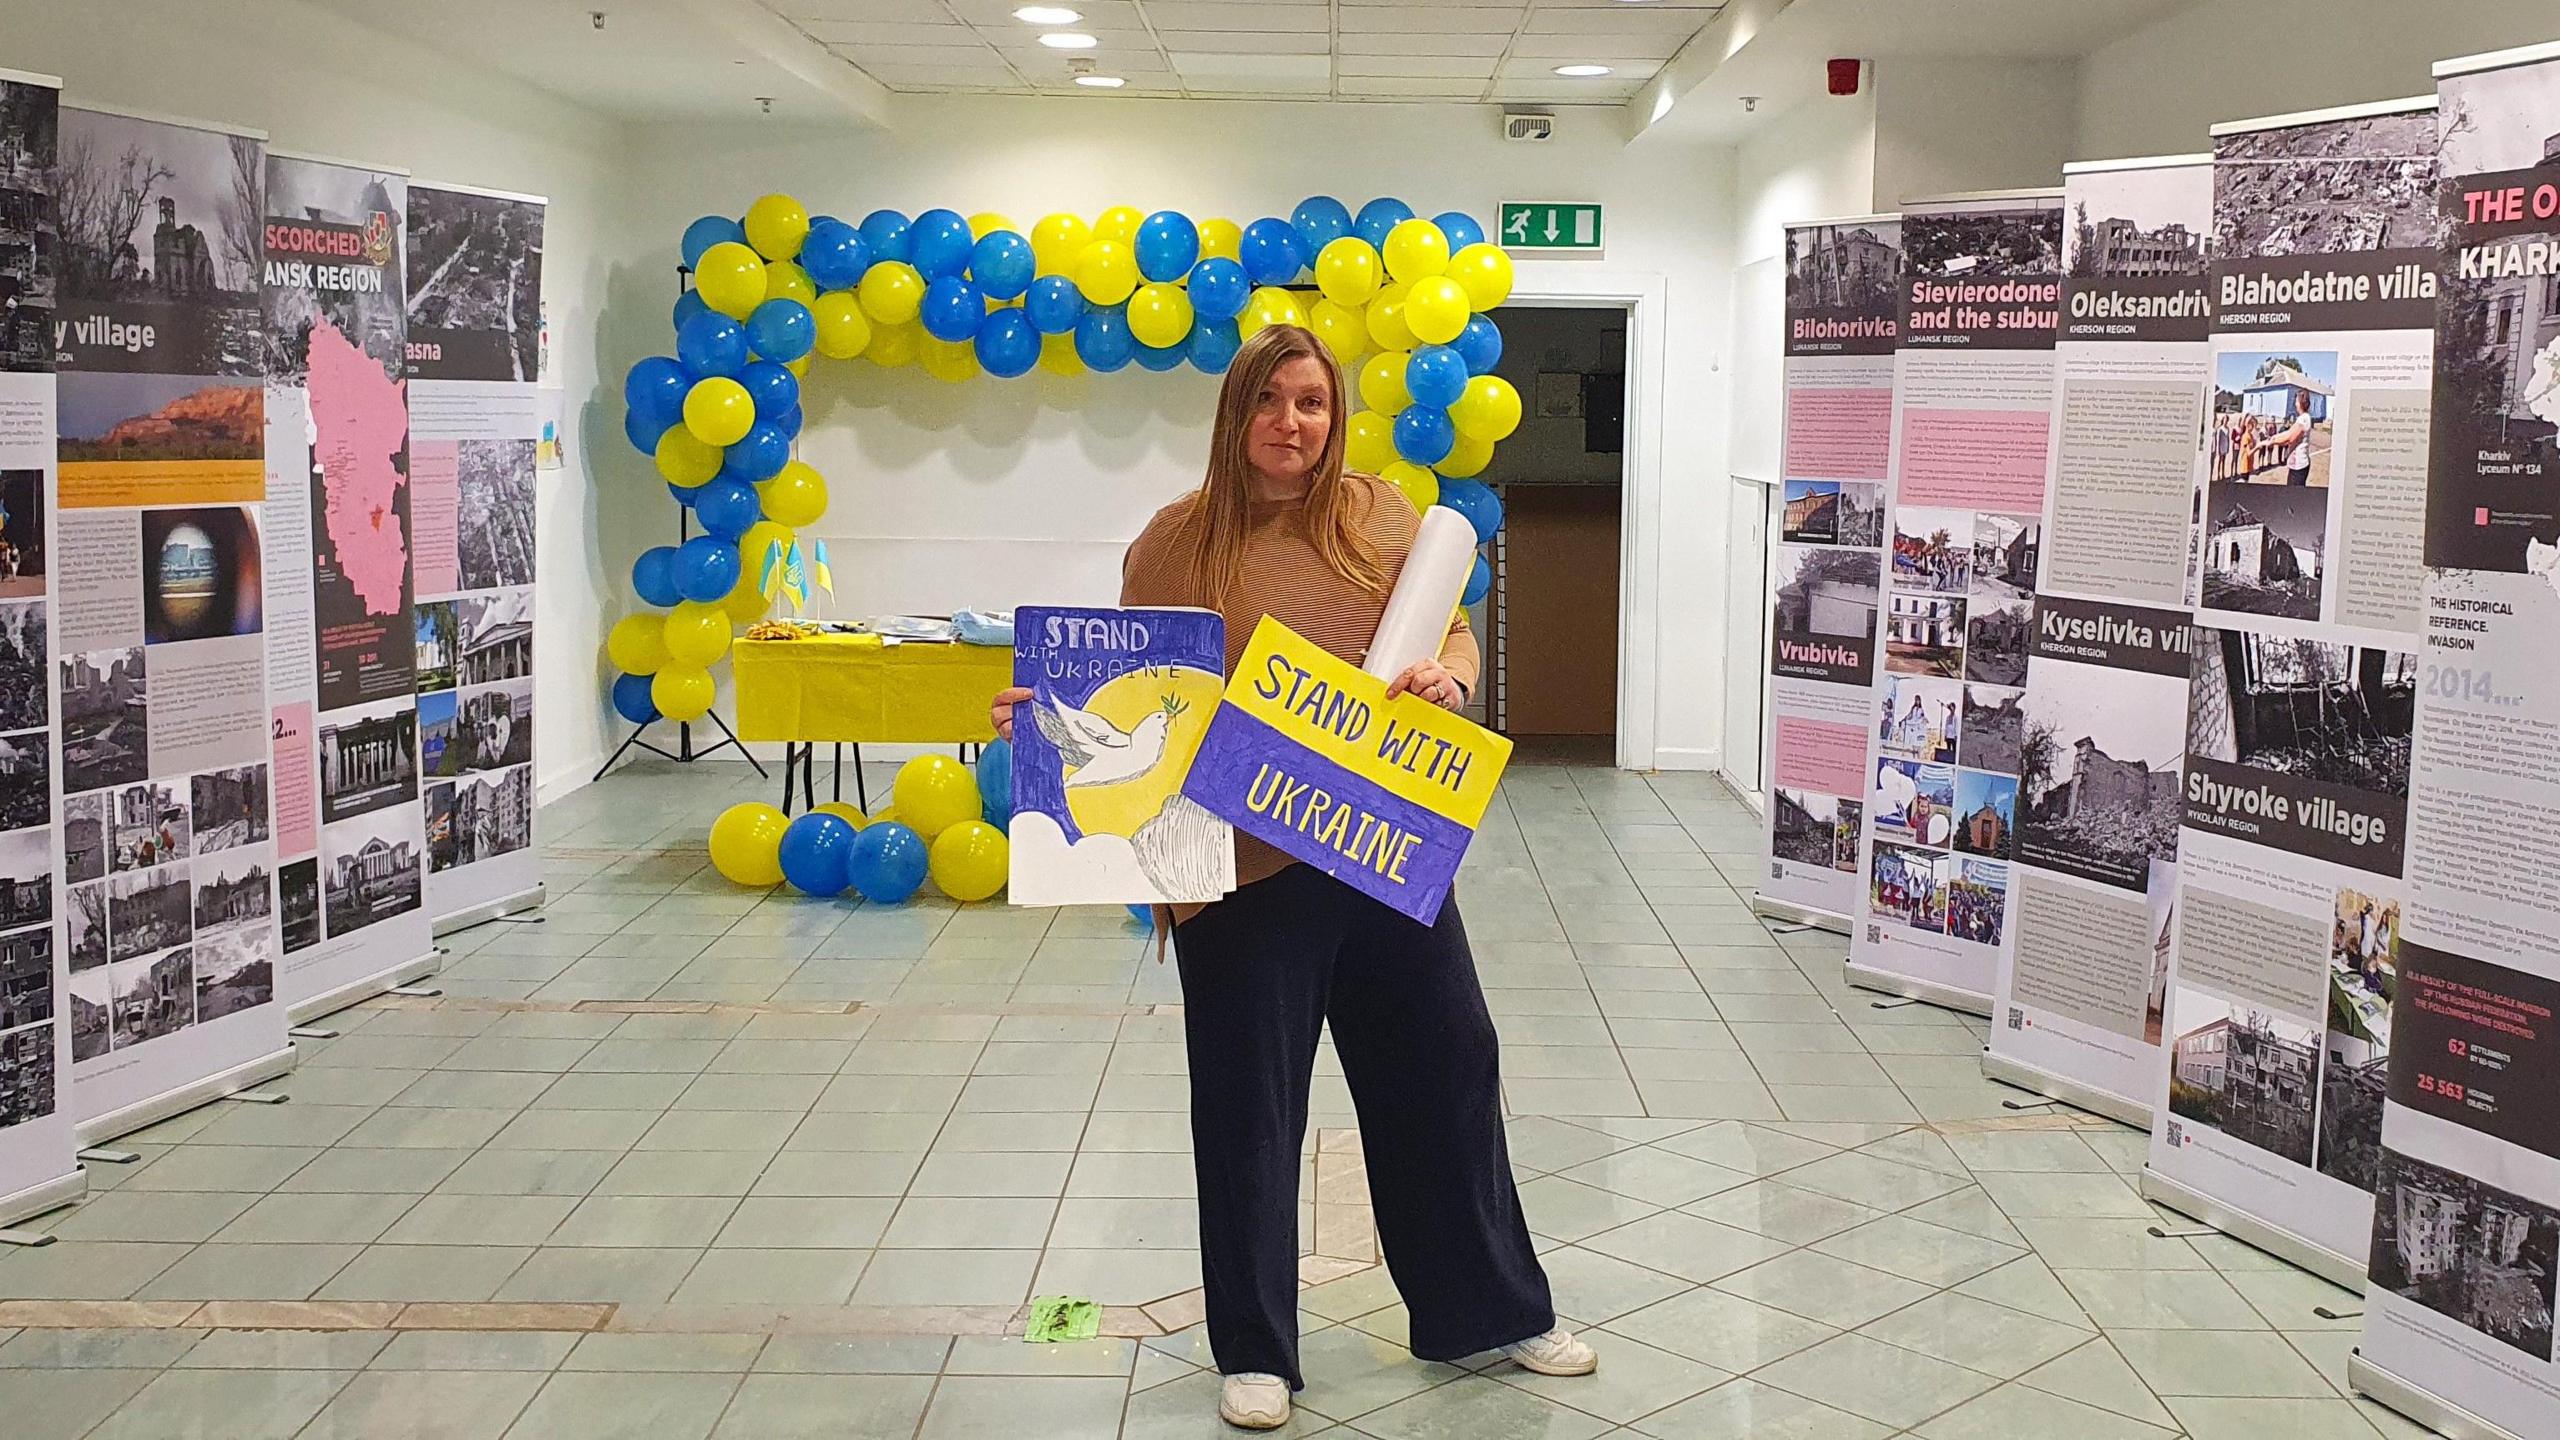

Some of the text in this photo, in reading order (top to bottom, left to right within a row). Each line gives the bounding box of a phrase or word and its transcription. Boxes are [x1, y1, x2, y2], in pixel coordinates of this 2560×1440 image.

[2464, 187, 2524, 225] THE
[266, 225, 361, 256] SCORCHED
[264, 261, 382, 293] ANSK REGION
[2220, 265, 2437, 306] Blahodatne villa
[1793, 316, 1896, 338] Bilohorivka
[1909, 306, 1950, 329] and
[1957, 306, 1991, 329] the
[2069, 324, 2136, 334] KHERSON REGION
[2220, 312, 2291, 324] KHERSON REGION
[74, 315, 155, 352] village
[1908, 335, 1970, 343] LUHANSK REGION
[2478, 450, 2511, 461] Kharkiv
[2477, 463, 2510, 475] Lyceum
[2526, 464, 2542, 475] 134
[2430, 596, 2513, 615] THE HISTORICAL
[1045, 616, 1150, 652] STAND
[2041, 609, 2153, 648] Kyselivka
[2429, 616, 2489, 632] REFERENCE.
[1014, 645, 1059, 660] WITH
[1779, 640, 1858, 667] Vrubivka
[2040, 642, 2107, 659] KHERSON REGION
[2428, 635, 2475, 650] INVASION
[1045, 659, 1182, 679] UKRAINE
[1254, 654, 1472, 792] STAND WITH
[2188, 772, 2386, 846] Shyroke village
[1246, 763, 1422, 884] UKRAINE
[2187, 809, 2260, 835] MYKOLAIV REGION
[2448, 1038, 2466, 1056] 62
[2418, 1073, 2434, 1092] 25
[2437, 1080, 2464, 1101] 563
